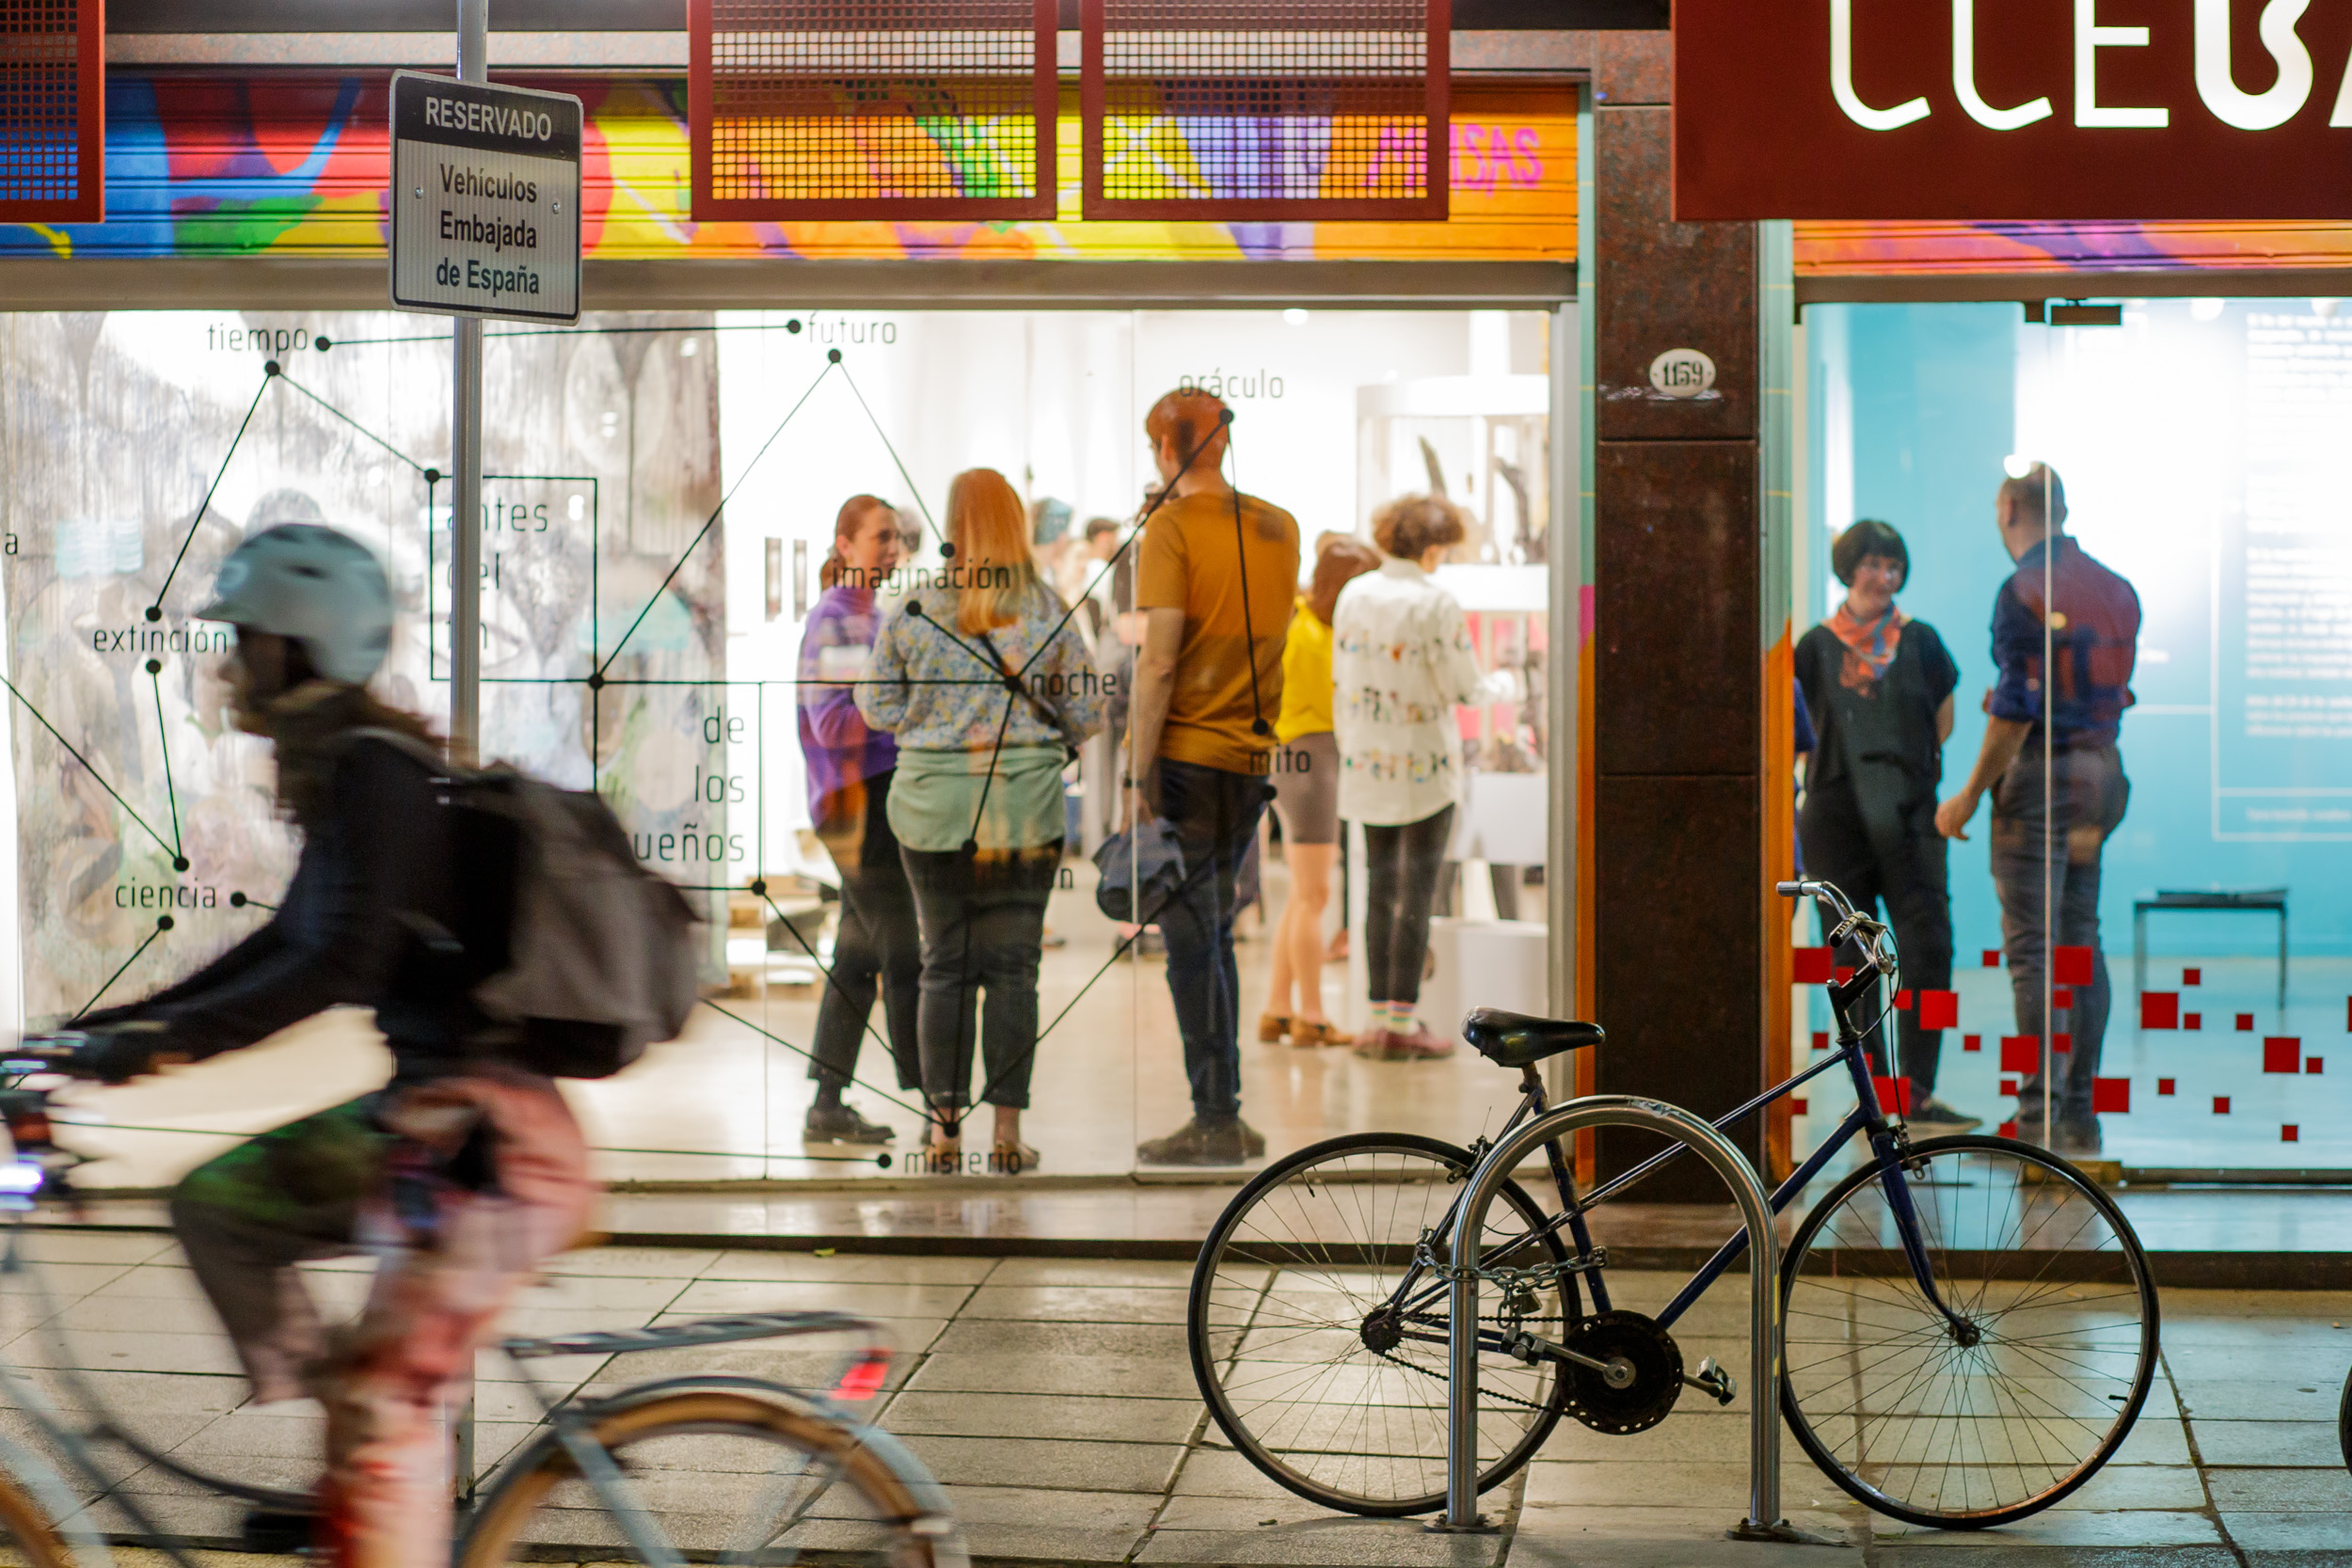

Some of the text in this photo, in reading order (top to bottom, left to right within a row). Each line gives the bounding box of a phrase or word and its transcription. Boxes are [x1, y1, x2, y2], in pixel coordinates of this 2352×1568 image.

[425, 97, 552, 141] RESERVADO
[439, 163, 537, 203] Vehículos
[440, 210, 537, 252] Embajada
[437, 257, 539, 297] de España
[207, 323, 308, 357] tiempo
[808, 309, 896, 344] futuro
[1180, 367, 1283, 398] oráculo
[832, 558, 1010, 596] imaginación
[94, 622, 227, 654] extinción
[1031, 665, 1116, 696] noche
[704, 705, 744, 744] de
[1249, 743, 1311, 773] mito
[694, 765, 744, 802] los
[633, 822, 744, 862] ueños
[116, 877, 215, 908] ciencia
[904, 1143, 1023, 1174] misterio
